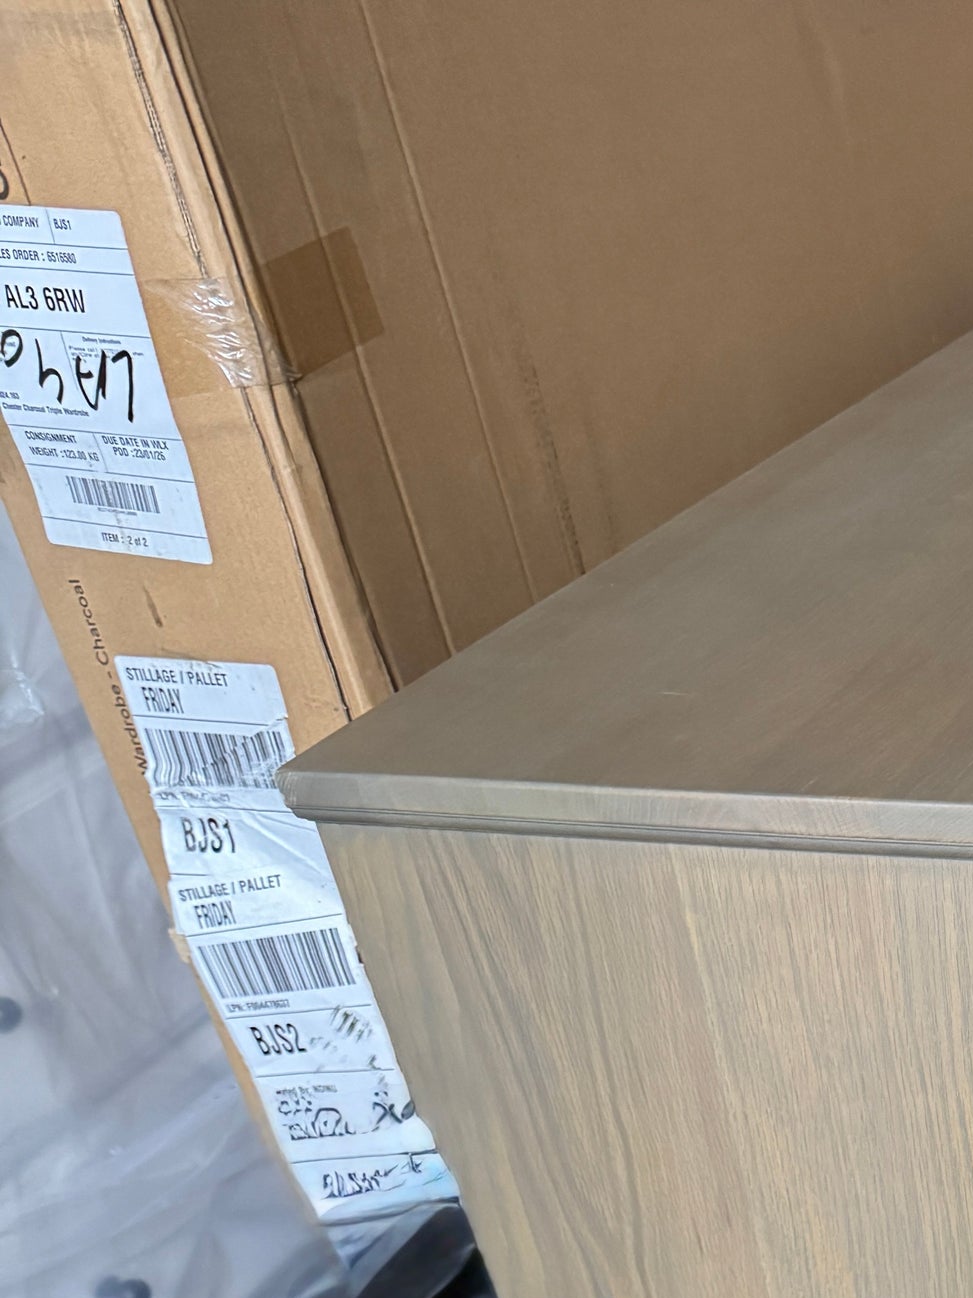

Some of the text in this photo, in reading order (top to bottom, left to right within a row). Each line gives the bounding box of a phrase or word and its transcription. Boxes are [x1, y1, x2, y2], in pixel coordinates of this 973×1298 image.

[2, 215, 39, 228] COMPANY
[12, 249, 40, 261] ORDER
[4, 284, 86, 314] AL3 6RW
[24, 430, 77, 444] CONSIGNMENT
[101, 435, 118, 446] DUE
[119, 436, 139, 448] DATE
[140, 439, 151, 449] IN
[29, 446, 59, 458] WEIGHT
[101, 532, 119, 543] ITEM
[142, 537, 149, 547] 2
[68, 579, 109, 666] Charcoal
[125, 667, 178, 684] STILLAGE
[187, 671, 230, 688] PALLET
[140, 686, 184, 714] FRIDAY
[180, 817, 236, 853] BJS1
[178, 882, 230, 902] STILLAGE
[238, 874, 282, 894] PALLET
[193, 900, 237, 929] FRIDAY
[249, 1023, 307, 1055] BJS2
